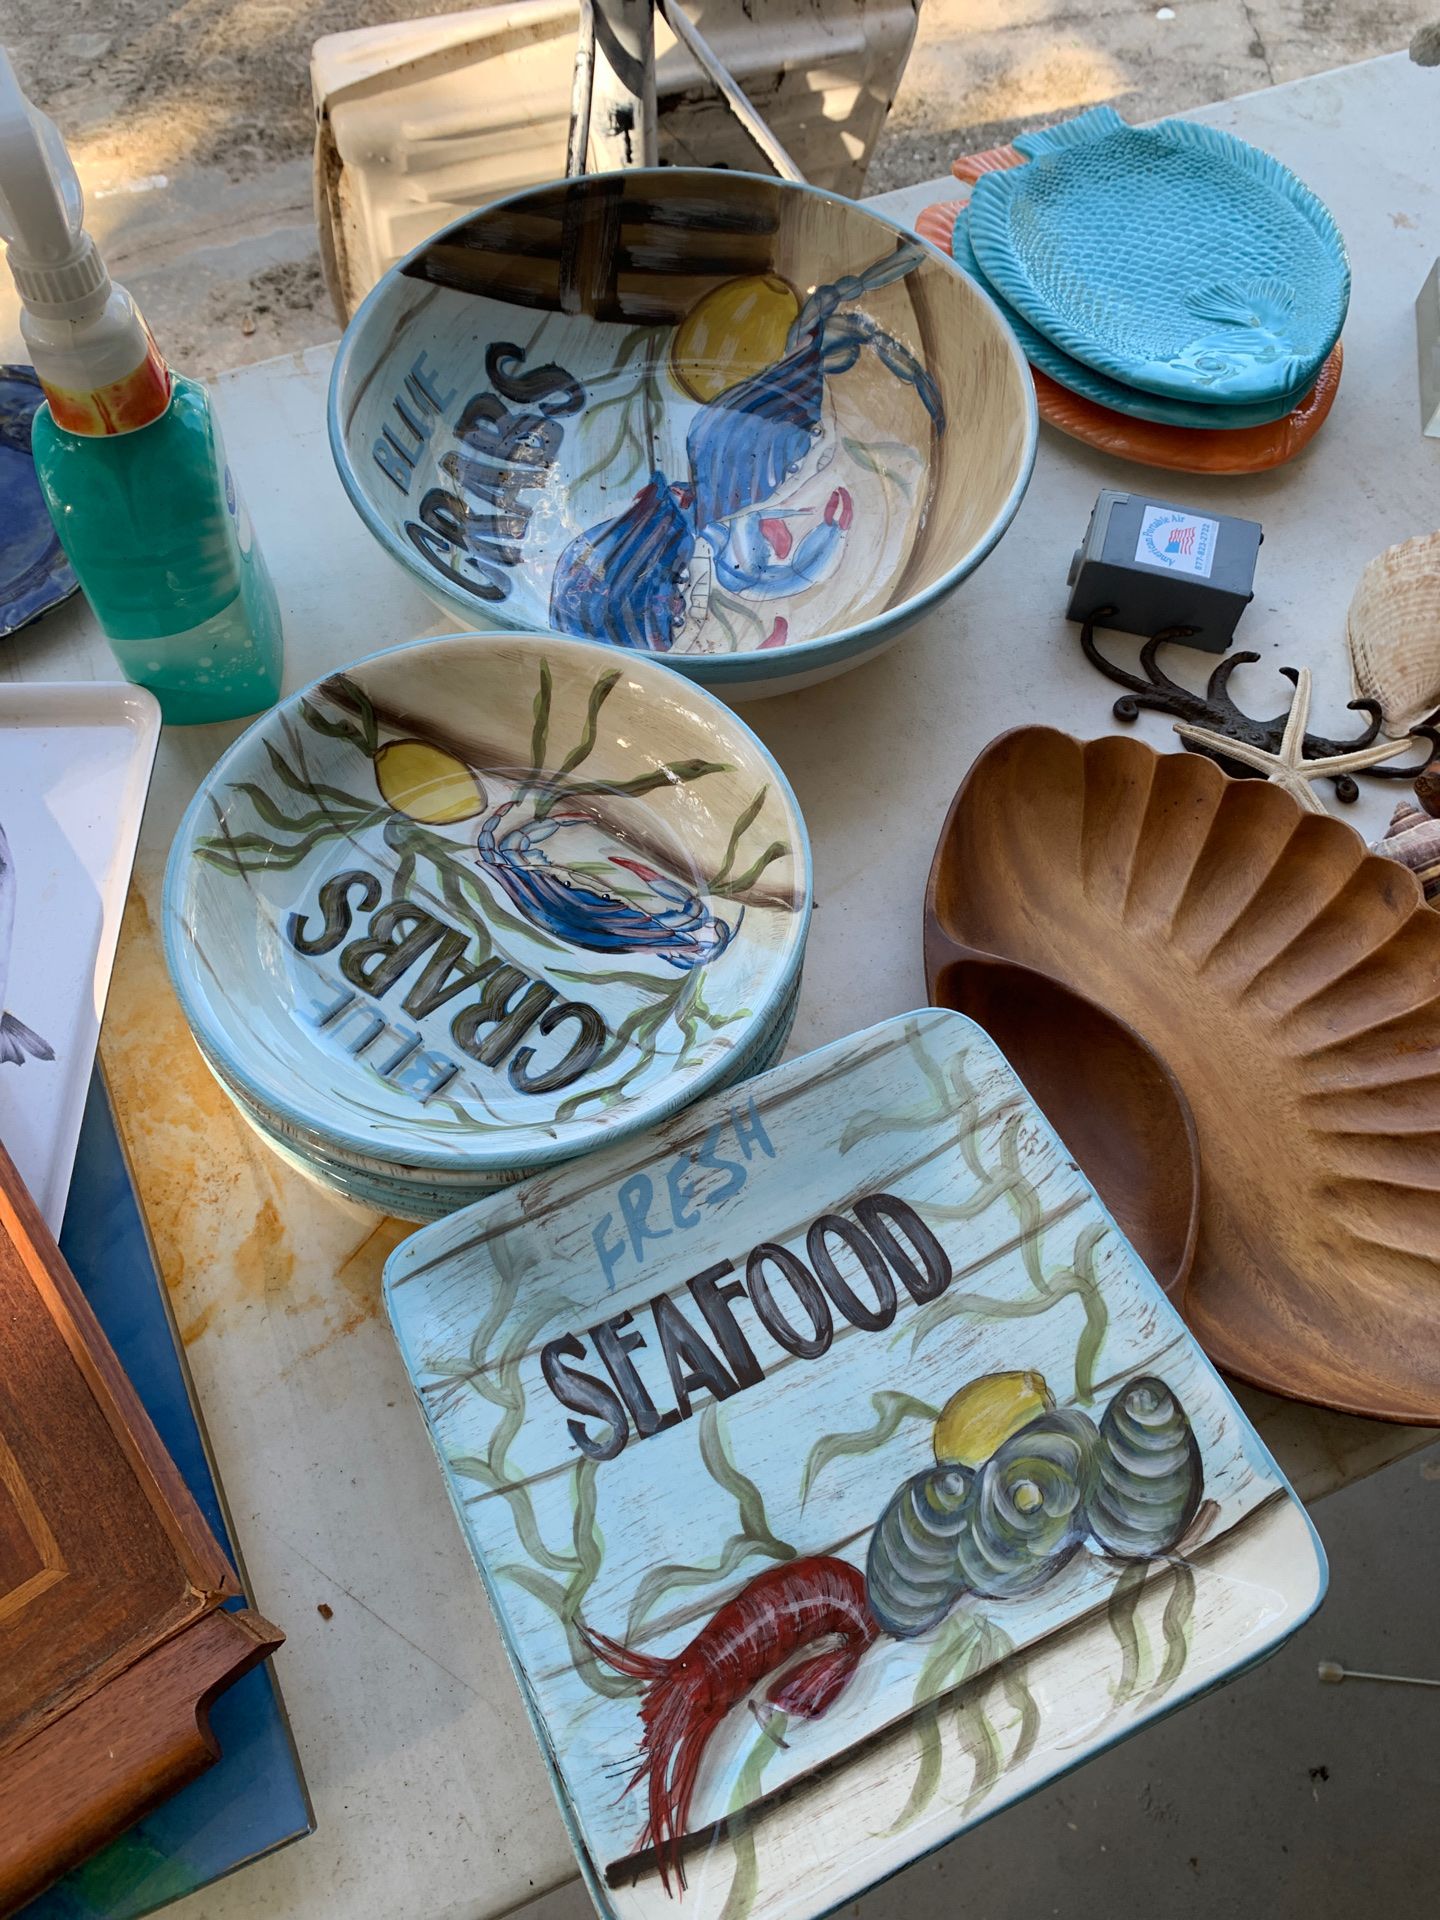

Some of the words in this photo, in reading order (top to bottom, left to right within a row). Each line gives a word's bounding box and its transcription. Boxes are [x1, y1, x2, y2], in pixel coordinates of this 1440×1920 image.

[373, 351, 457, 496] BLUE
[404, 341, 586, 603] CRABS
[1142, 516, 1170, 537] Portable
[1145, 537, 1175, 566] American
[1171, 514, 1185, 523] Air
[287, 870, 606, 1095] CRABS
[309, 981, 460, 1105] BLUE
[593, 1095, 776, 1290] FRESH
[540, 1194, 952, 1461] SEAFOOD
